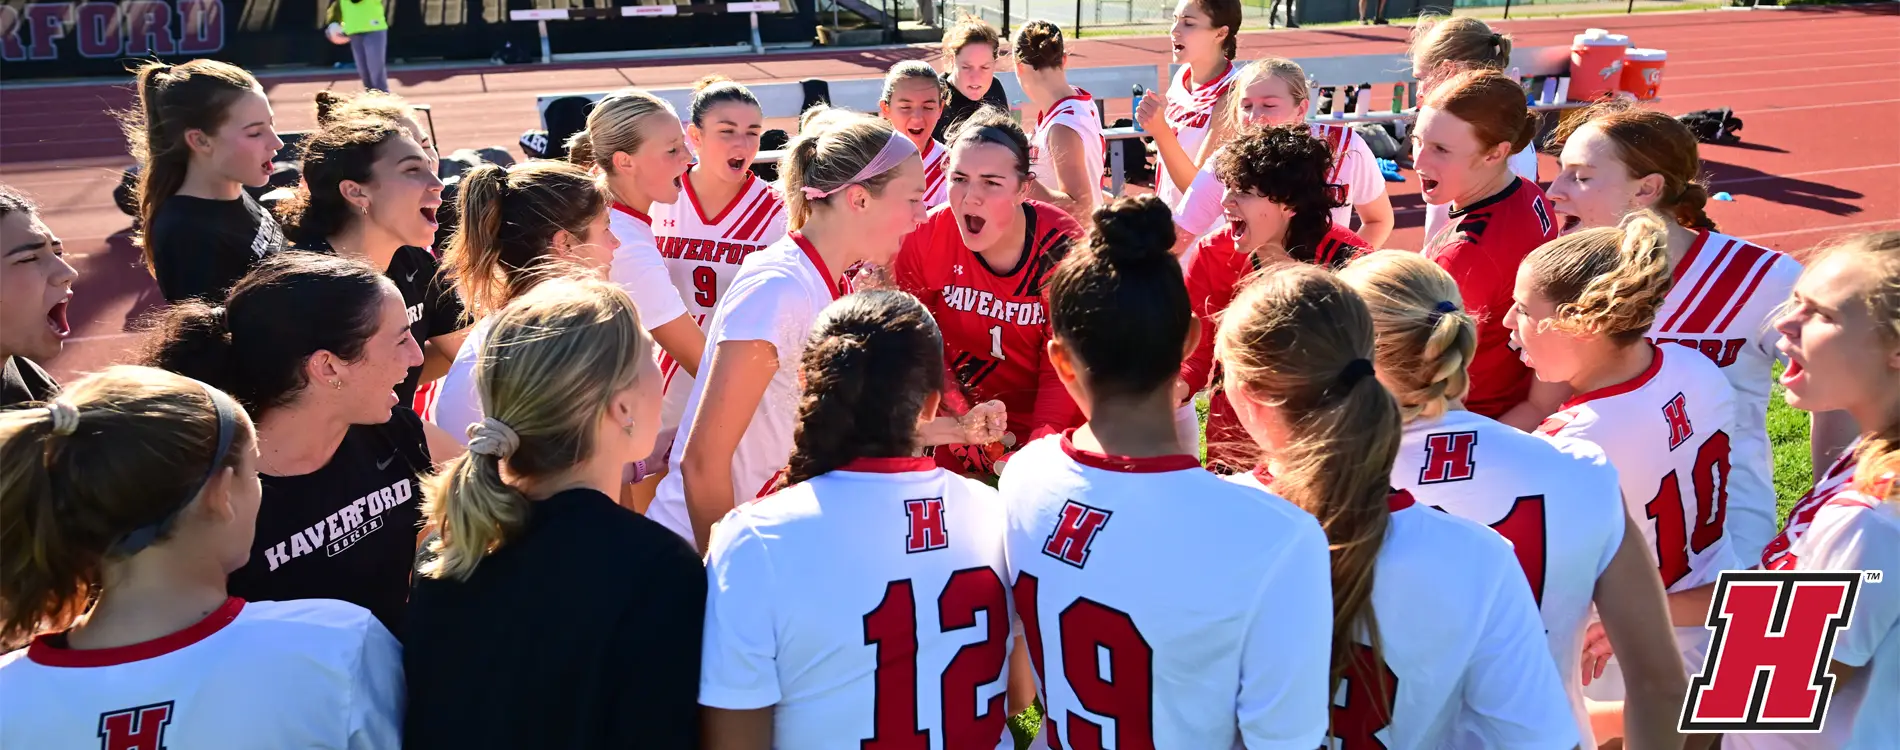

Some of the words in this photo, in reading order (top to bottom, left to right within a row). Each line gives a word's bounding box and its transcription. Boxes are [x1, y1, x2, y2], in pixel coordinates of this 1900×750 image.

[1532, 195, 1551, 237] H
[654, 236, 767, 265] HAVERFOR
[693, 266, 716, 307] 9
[989, 325, 1006, 361] 1
[1662, 391, 1694, 452] H
[1418, 430, 1478, 485] H
[264, 478, 412, 572] HAVERFORD
[333, 520, 378, 552] SOCCER
[904, 496, 948, 554] H
[1041, 498, 1113, 569] H
[1645, 429, 1731, 590] 10
[860, 565, 1010, 750] 12
[1011, 569, 1156, 750] 19
[97, 699, 175, 750] H
